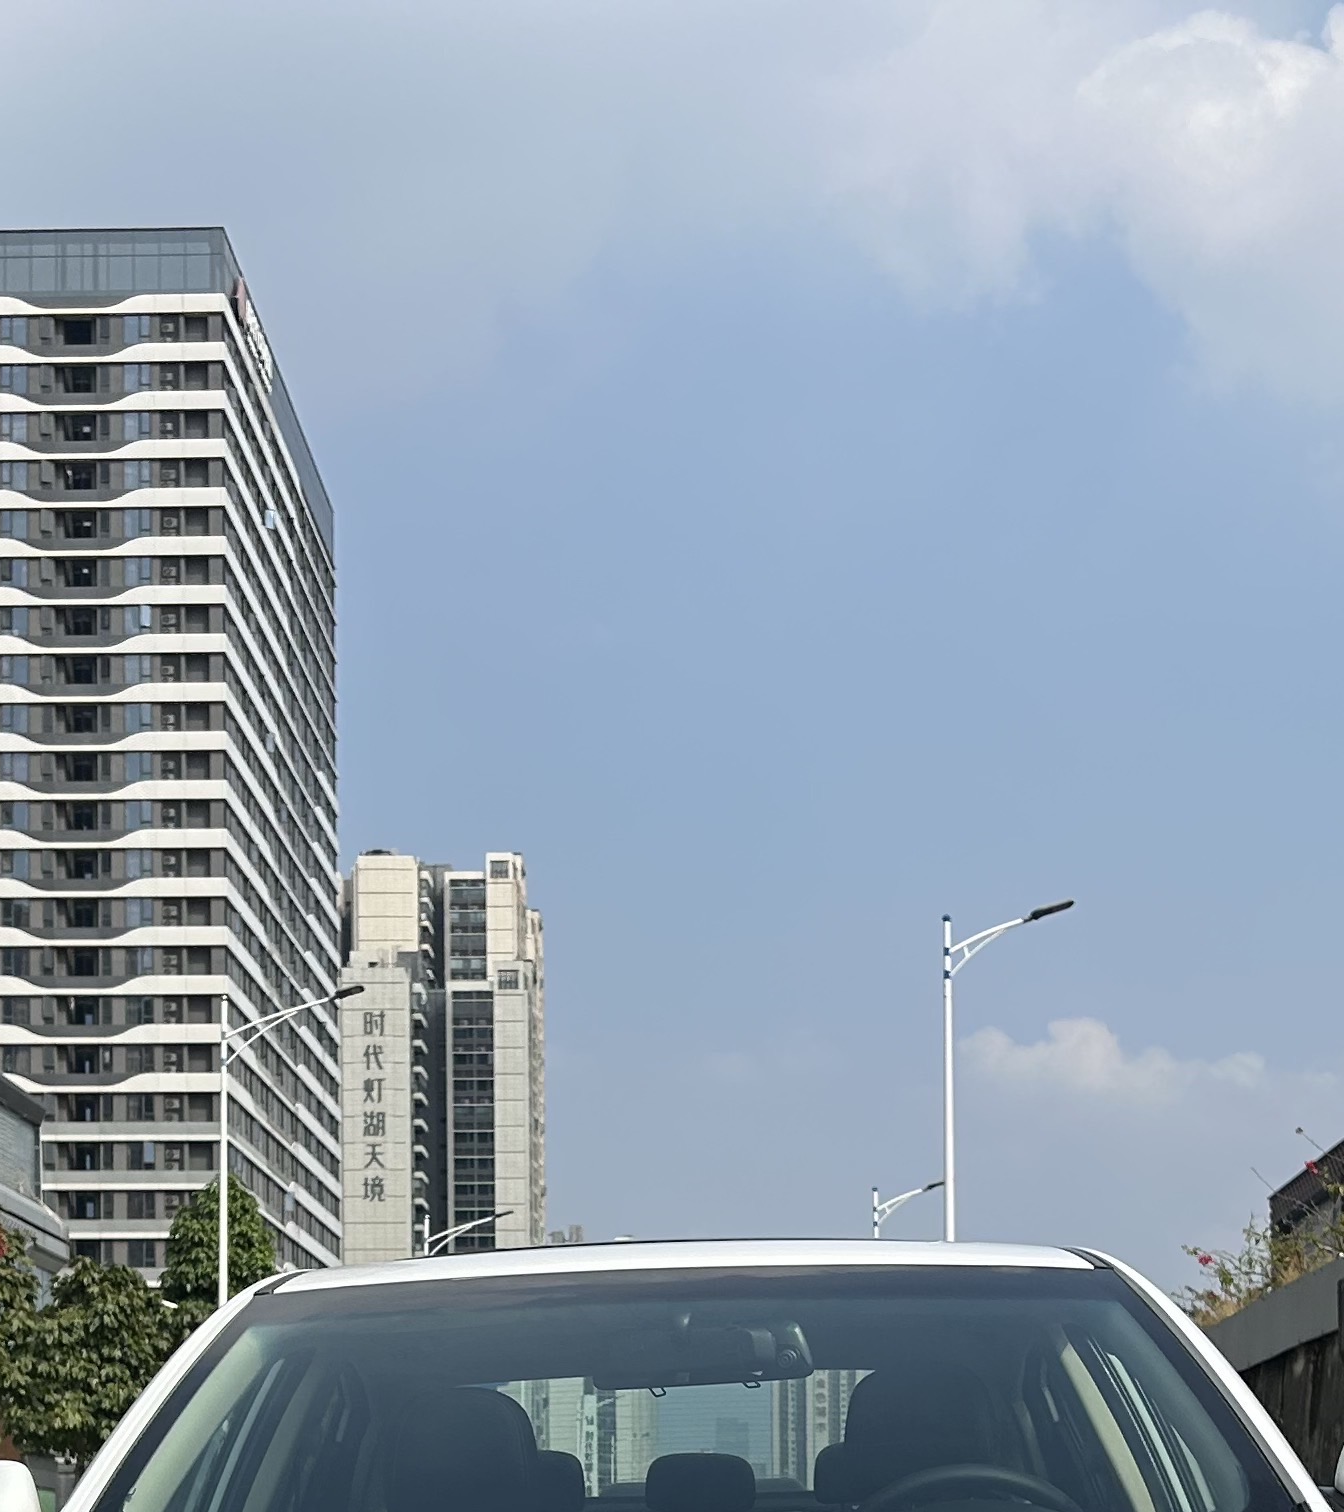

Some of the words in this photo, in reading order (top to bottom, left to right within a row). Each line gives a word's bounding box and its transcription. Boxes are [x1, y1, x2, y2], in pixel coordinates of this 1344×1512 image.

[362, 1010, 387, 1203] 时代灯湖天境
